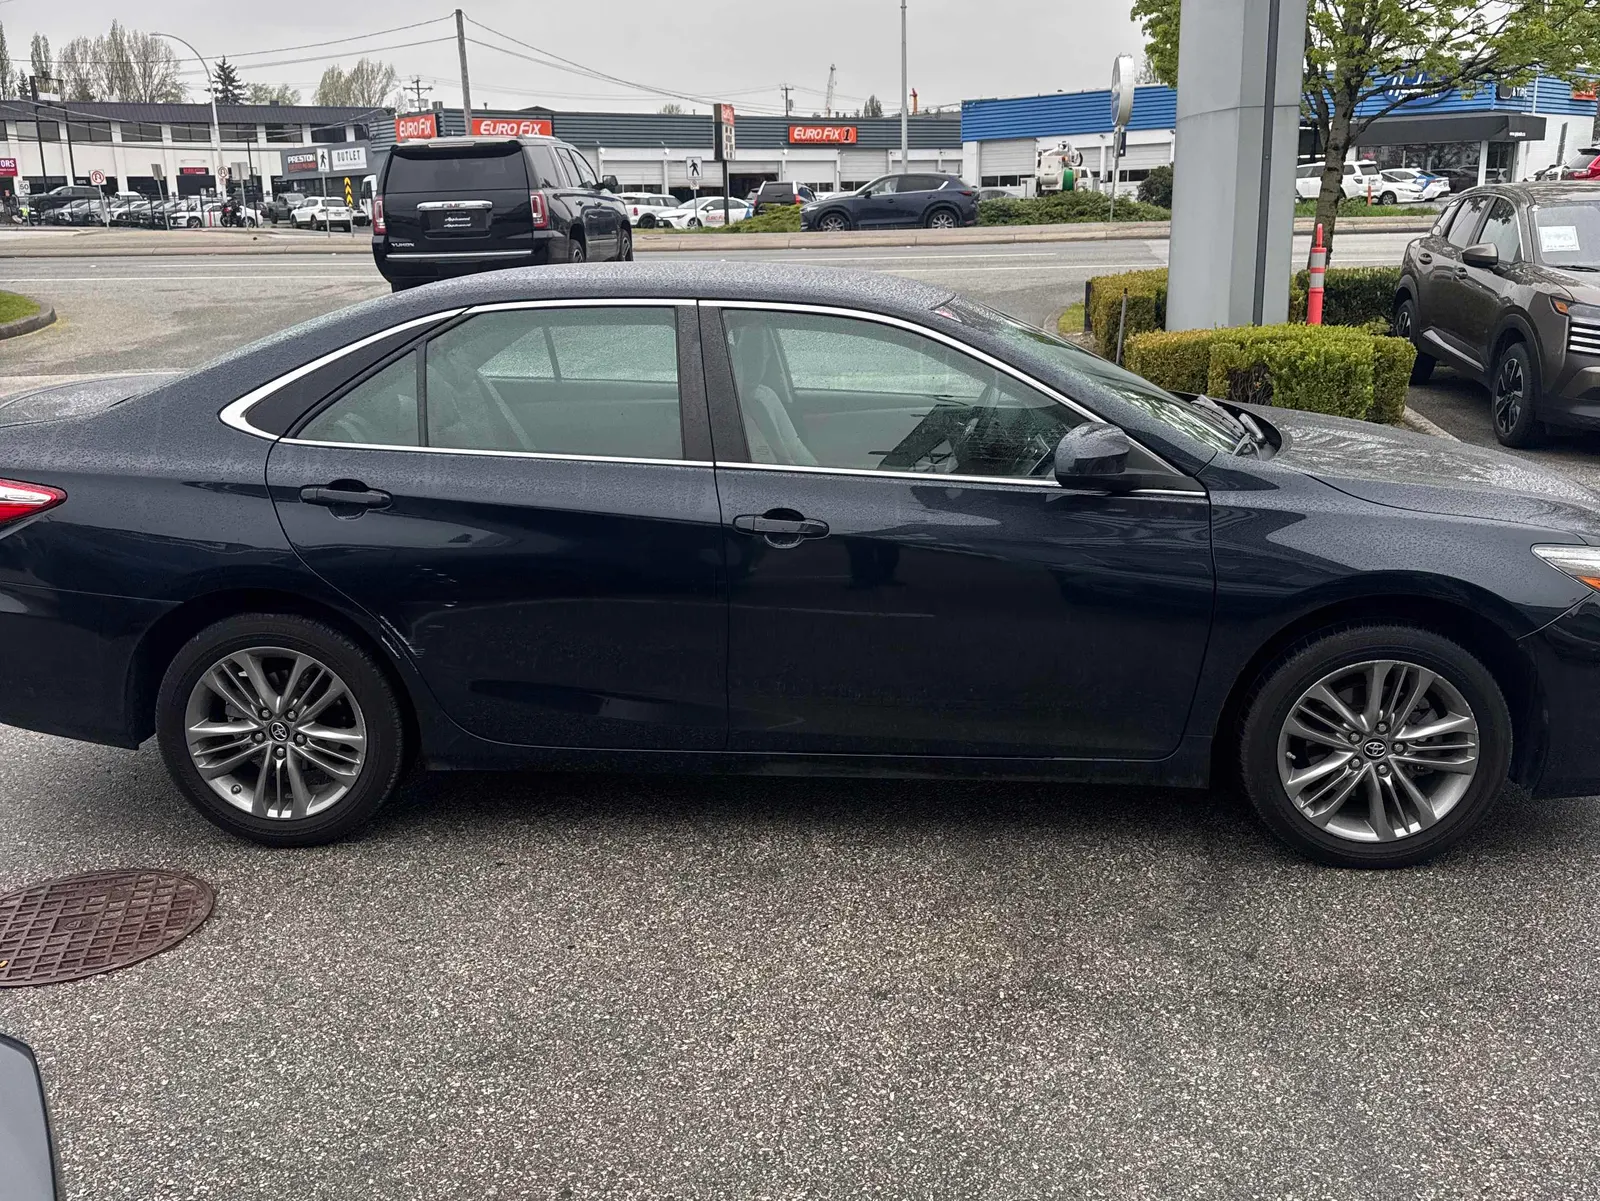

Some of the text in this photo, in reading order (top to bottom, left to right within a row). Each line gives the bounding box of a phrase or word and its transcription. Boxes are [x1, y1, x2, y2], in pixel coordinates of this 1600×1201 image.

[399, 118, 432, 137] EURO FIX
[480, 120, 542, 135] EURO FIX
[793, 126, 823, 140] EURO
[823, 126, 841, 140] FIX
[287, 153, 317, 164] PRESTON
[336, 150, 361, 162] OUTLET
